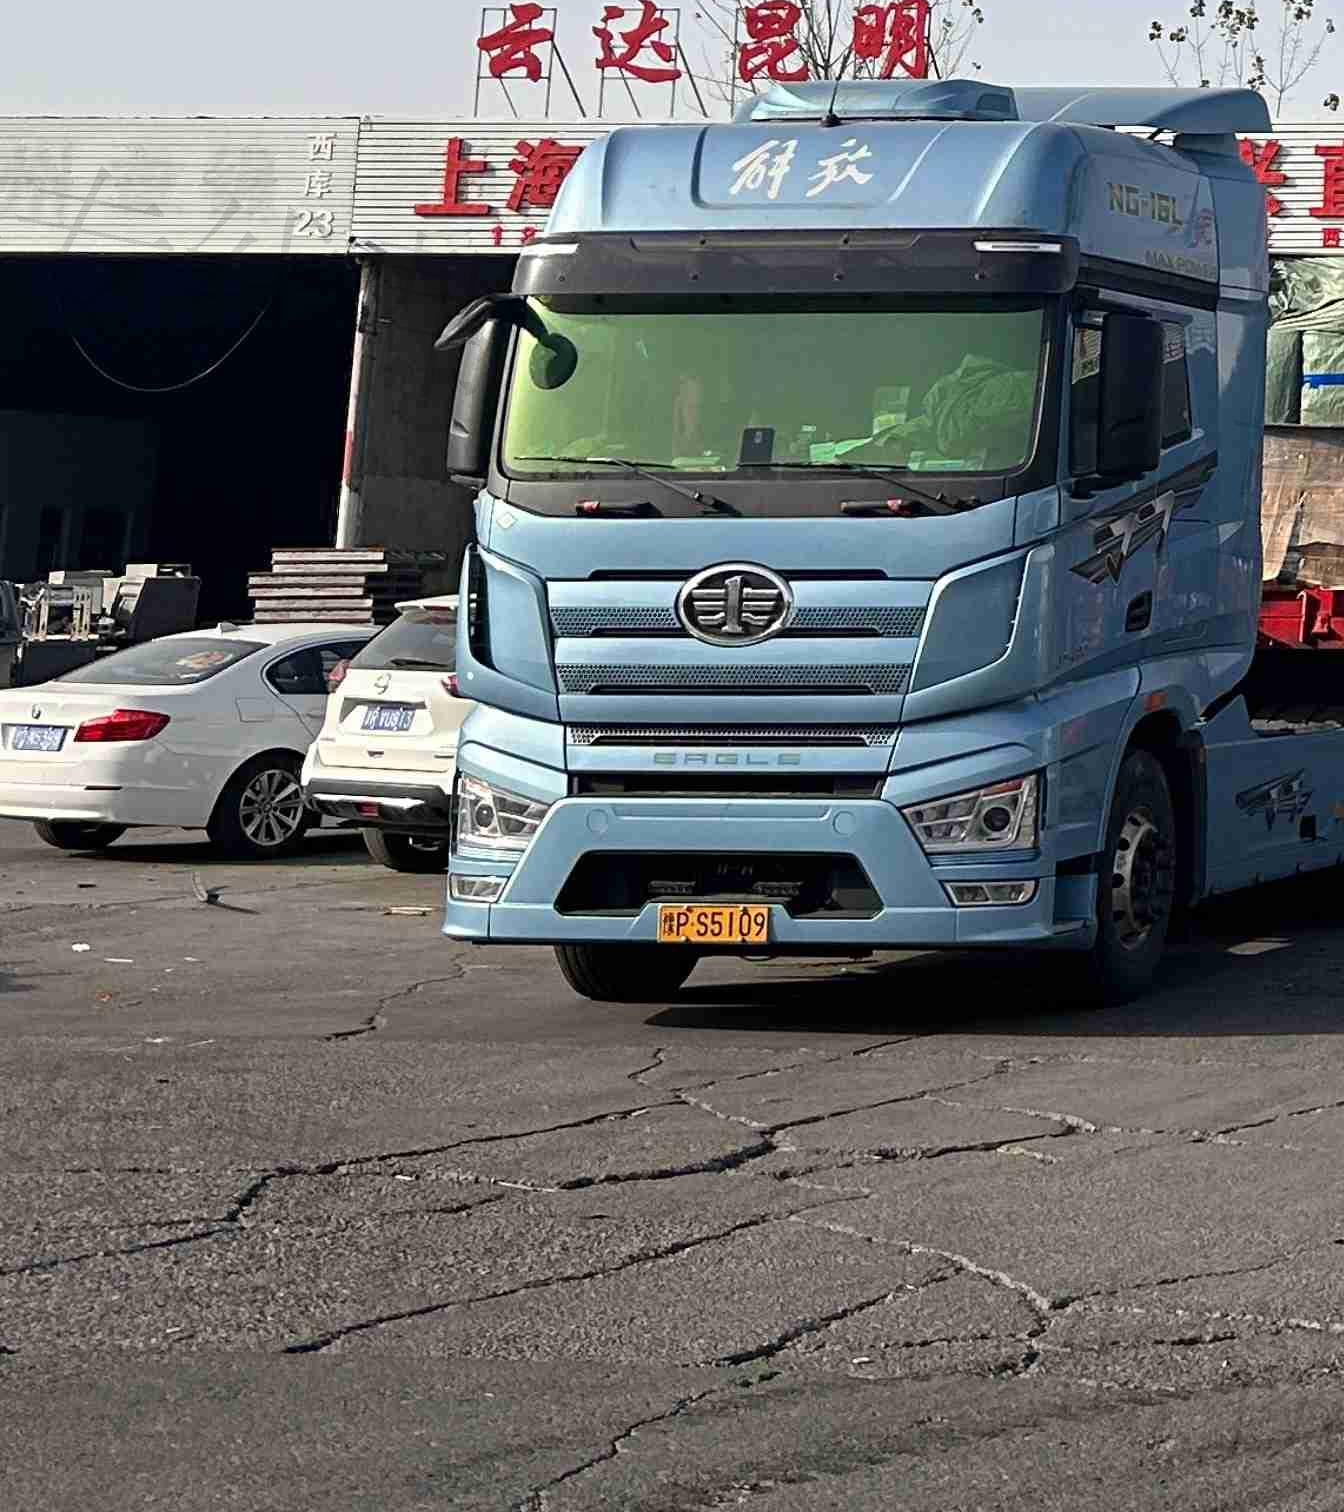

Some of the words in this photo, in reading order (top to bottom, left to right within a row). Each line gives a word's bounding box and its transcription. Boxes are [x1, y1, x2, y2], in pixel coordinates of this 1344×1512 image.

[415, 136, 585, 217] 上海
[729, 138, 873, 200] 解放
[653, 752, 802, 767] EAGLE
